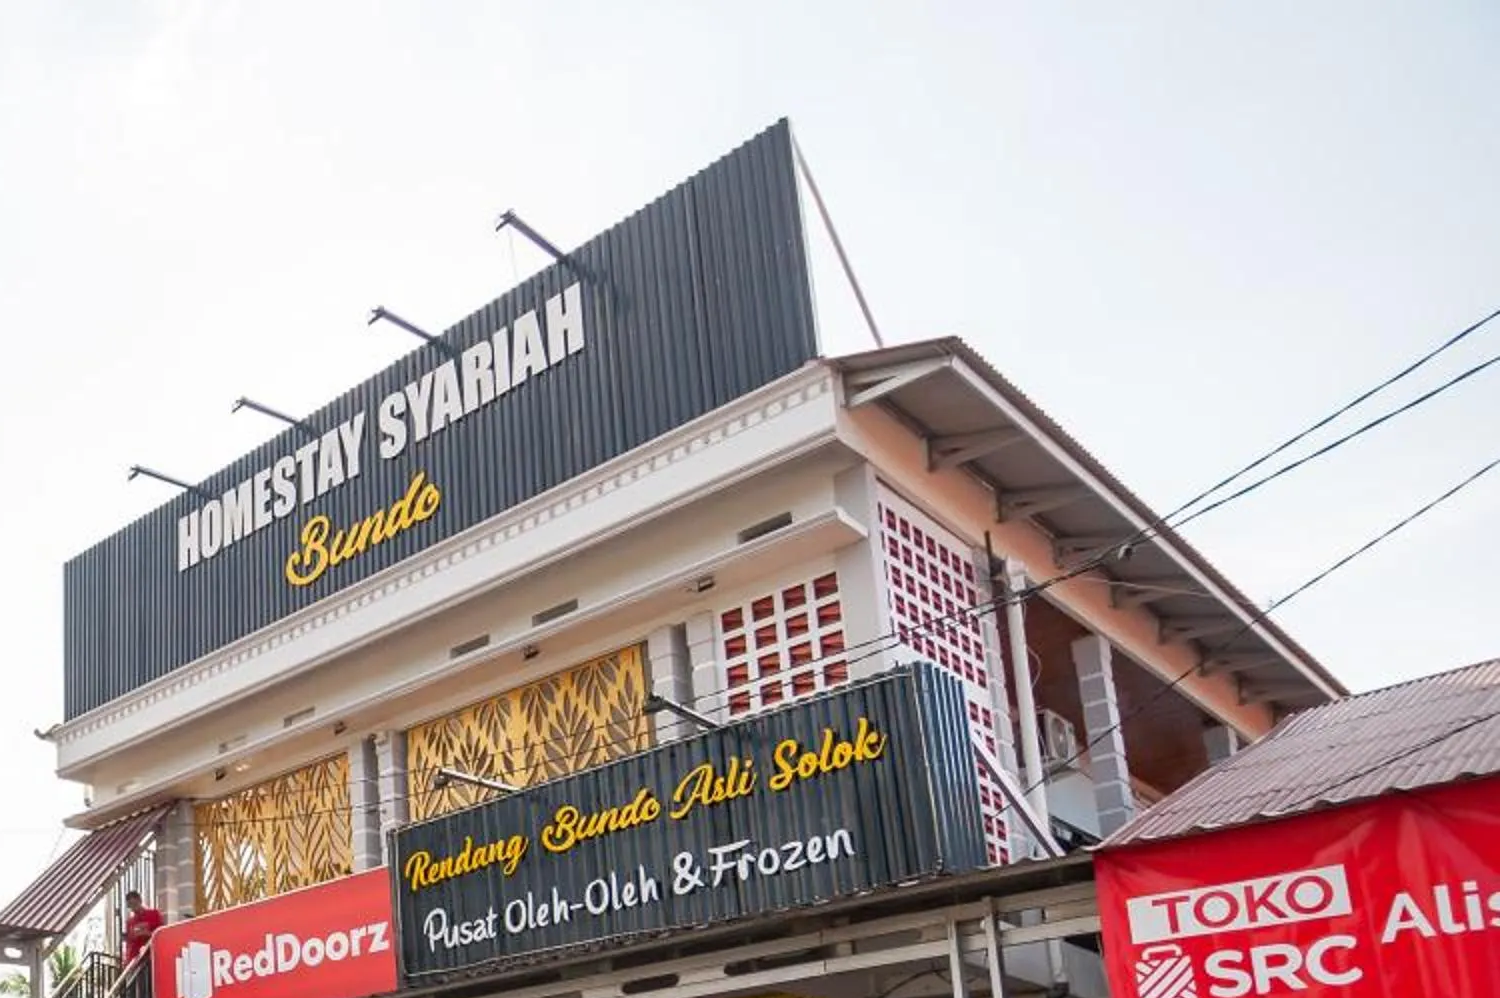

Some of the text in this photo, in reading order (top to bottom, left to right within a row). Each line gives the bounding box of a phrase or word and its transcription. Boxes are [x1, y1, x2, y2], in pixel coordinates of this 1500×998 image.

[178, 282, 586, 572] HOMESTAY SYARIAH
[285, 470, 441, 586] Bundo
[404, 717, 888, 892] Rendang Bundo Asli Solok
[423, 828, 856, 953] Pusat Oleh-Oleh & Frozen
[1151, 877, 1334, 935] TOKO
[213, 921, 390, 988] RedDoorz
[1205, 935, 1363, 998] SRC
